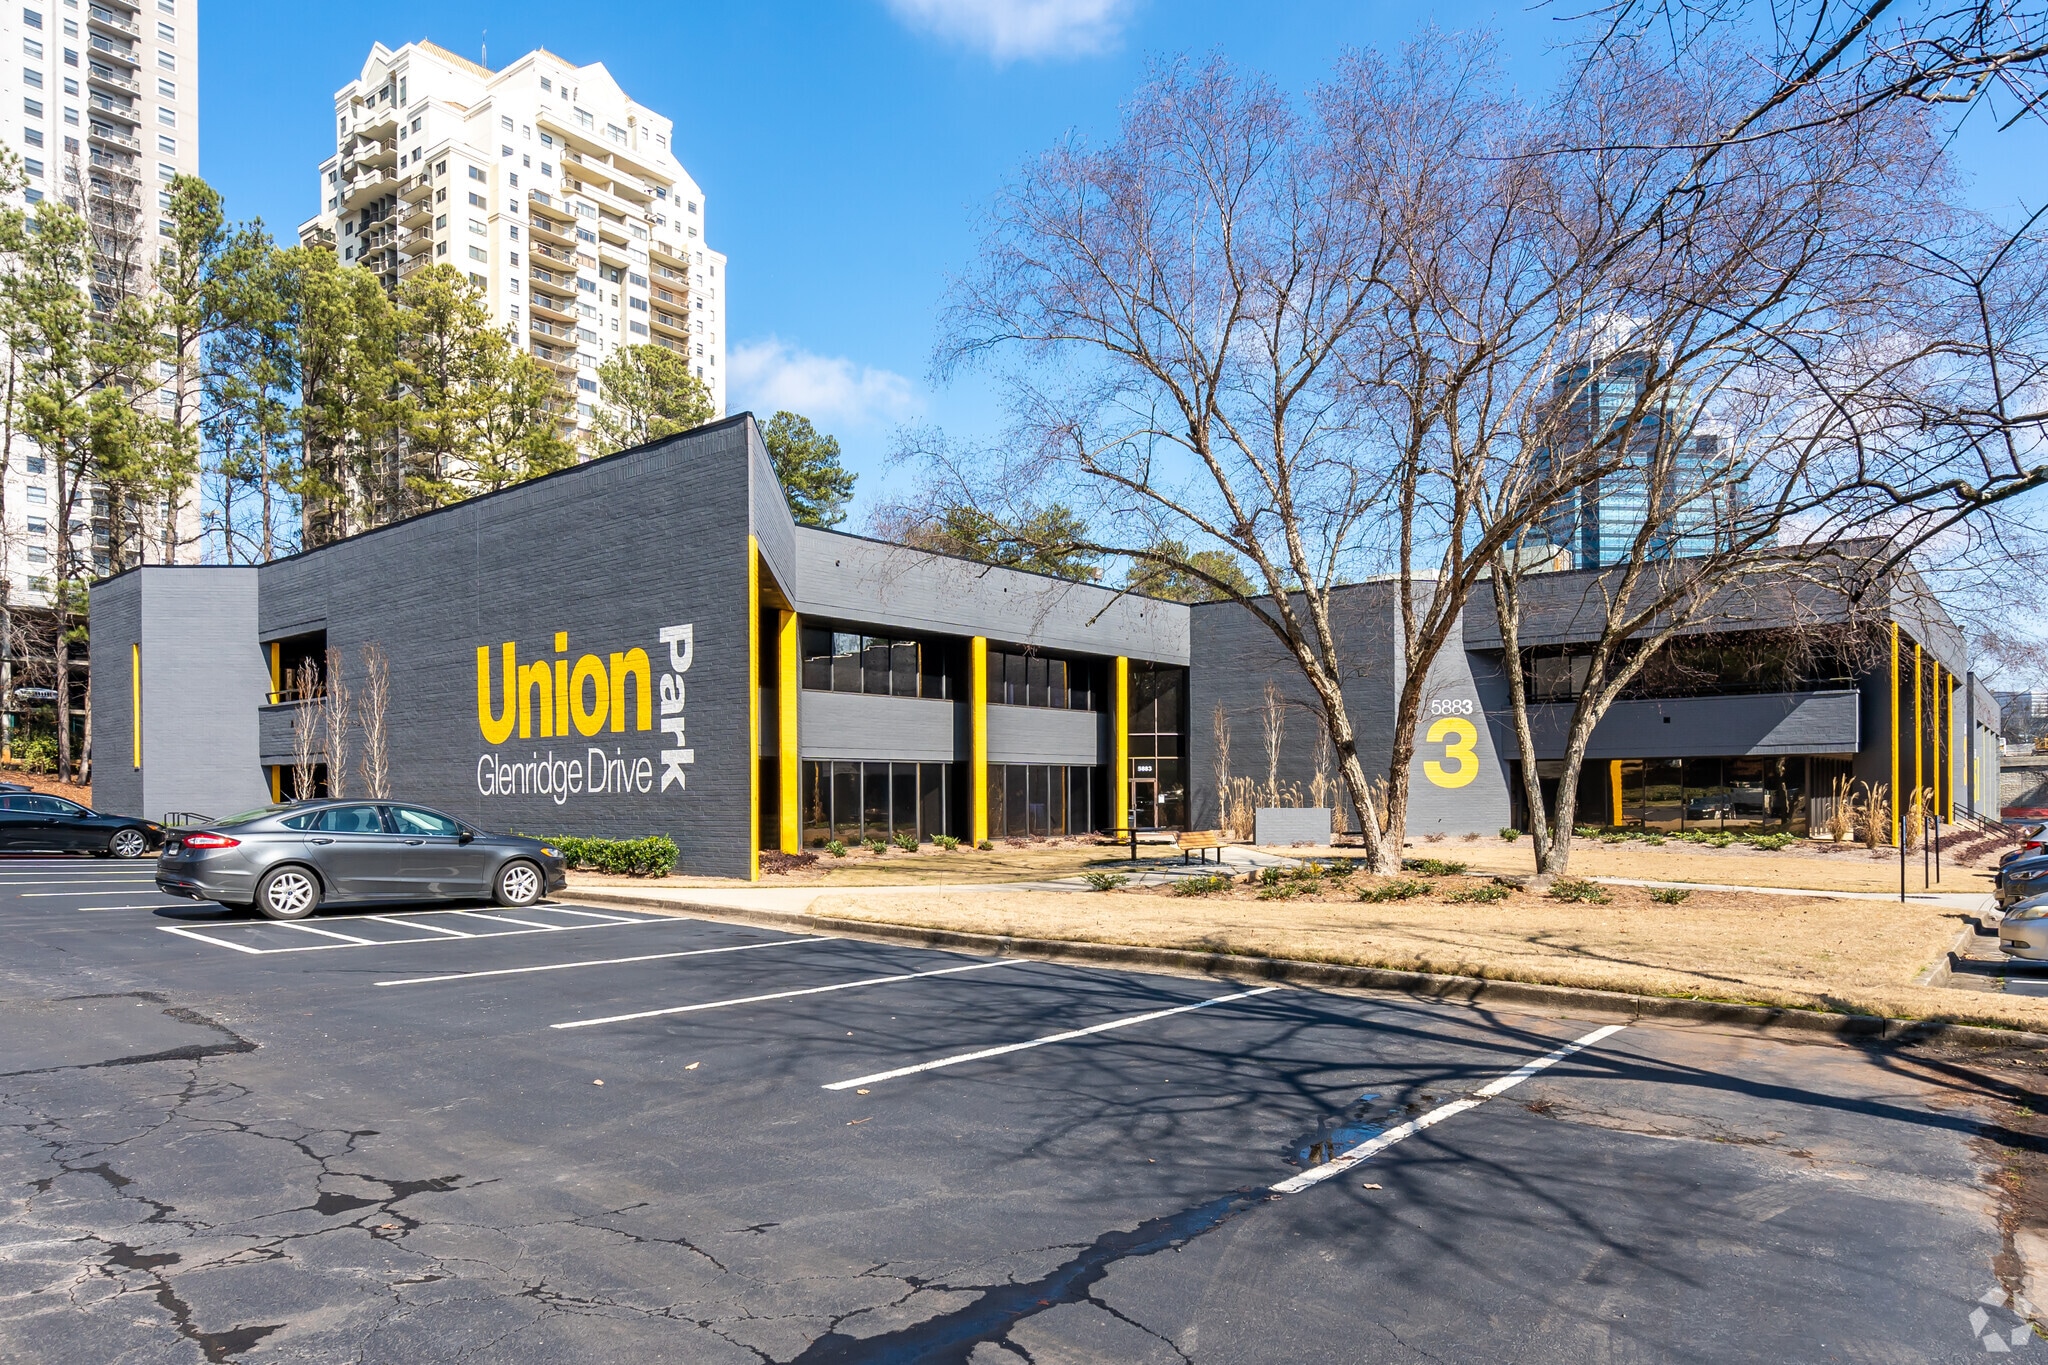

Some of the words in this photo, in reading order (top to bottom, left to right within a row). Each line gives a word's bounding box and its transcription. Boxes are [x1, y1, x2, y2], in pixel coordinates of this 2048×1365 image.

[476, 631, 652, 745] Union
[659, 623, 694, 793] Park
[1431, 699, 1473, 715] 5883
[477, 751, 583, 805] Glenridge
[587, 747, 653, 793] Drive
[1423, 716, 1479, 789] 3
